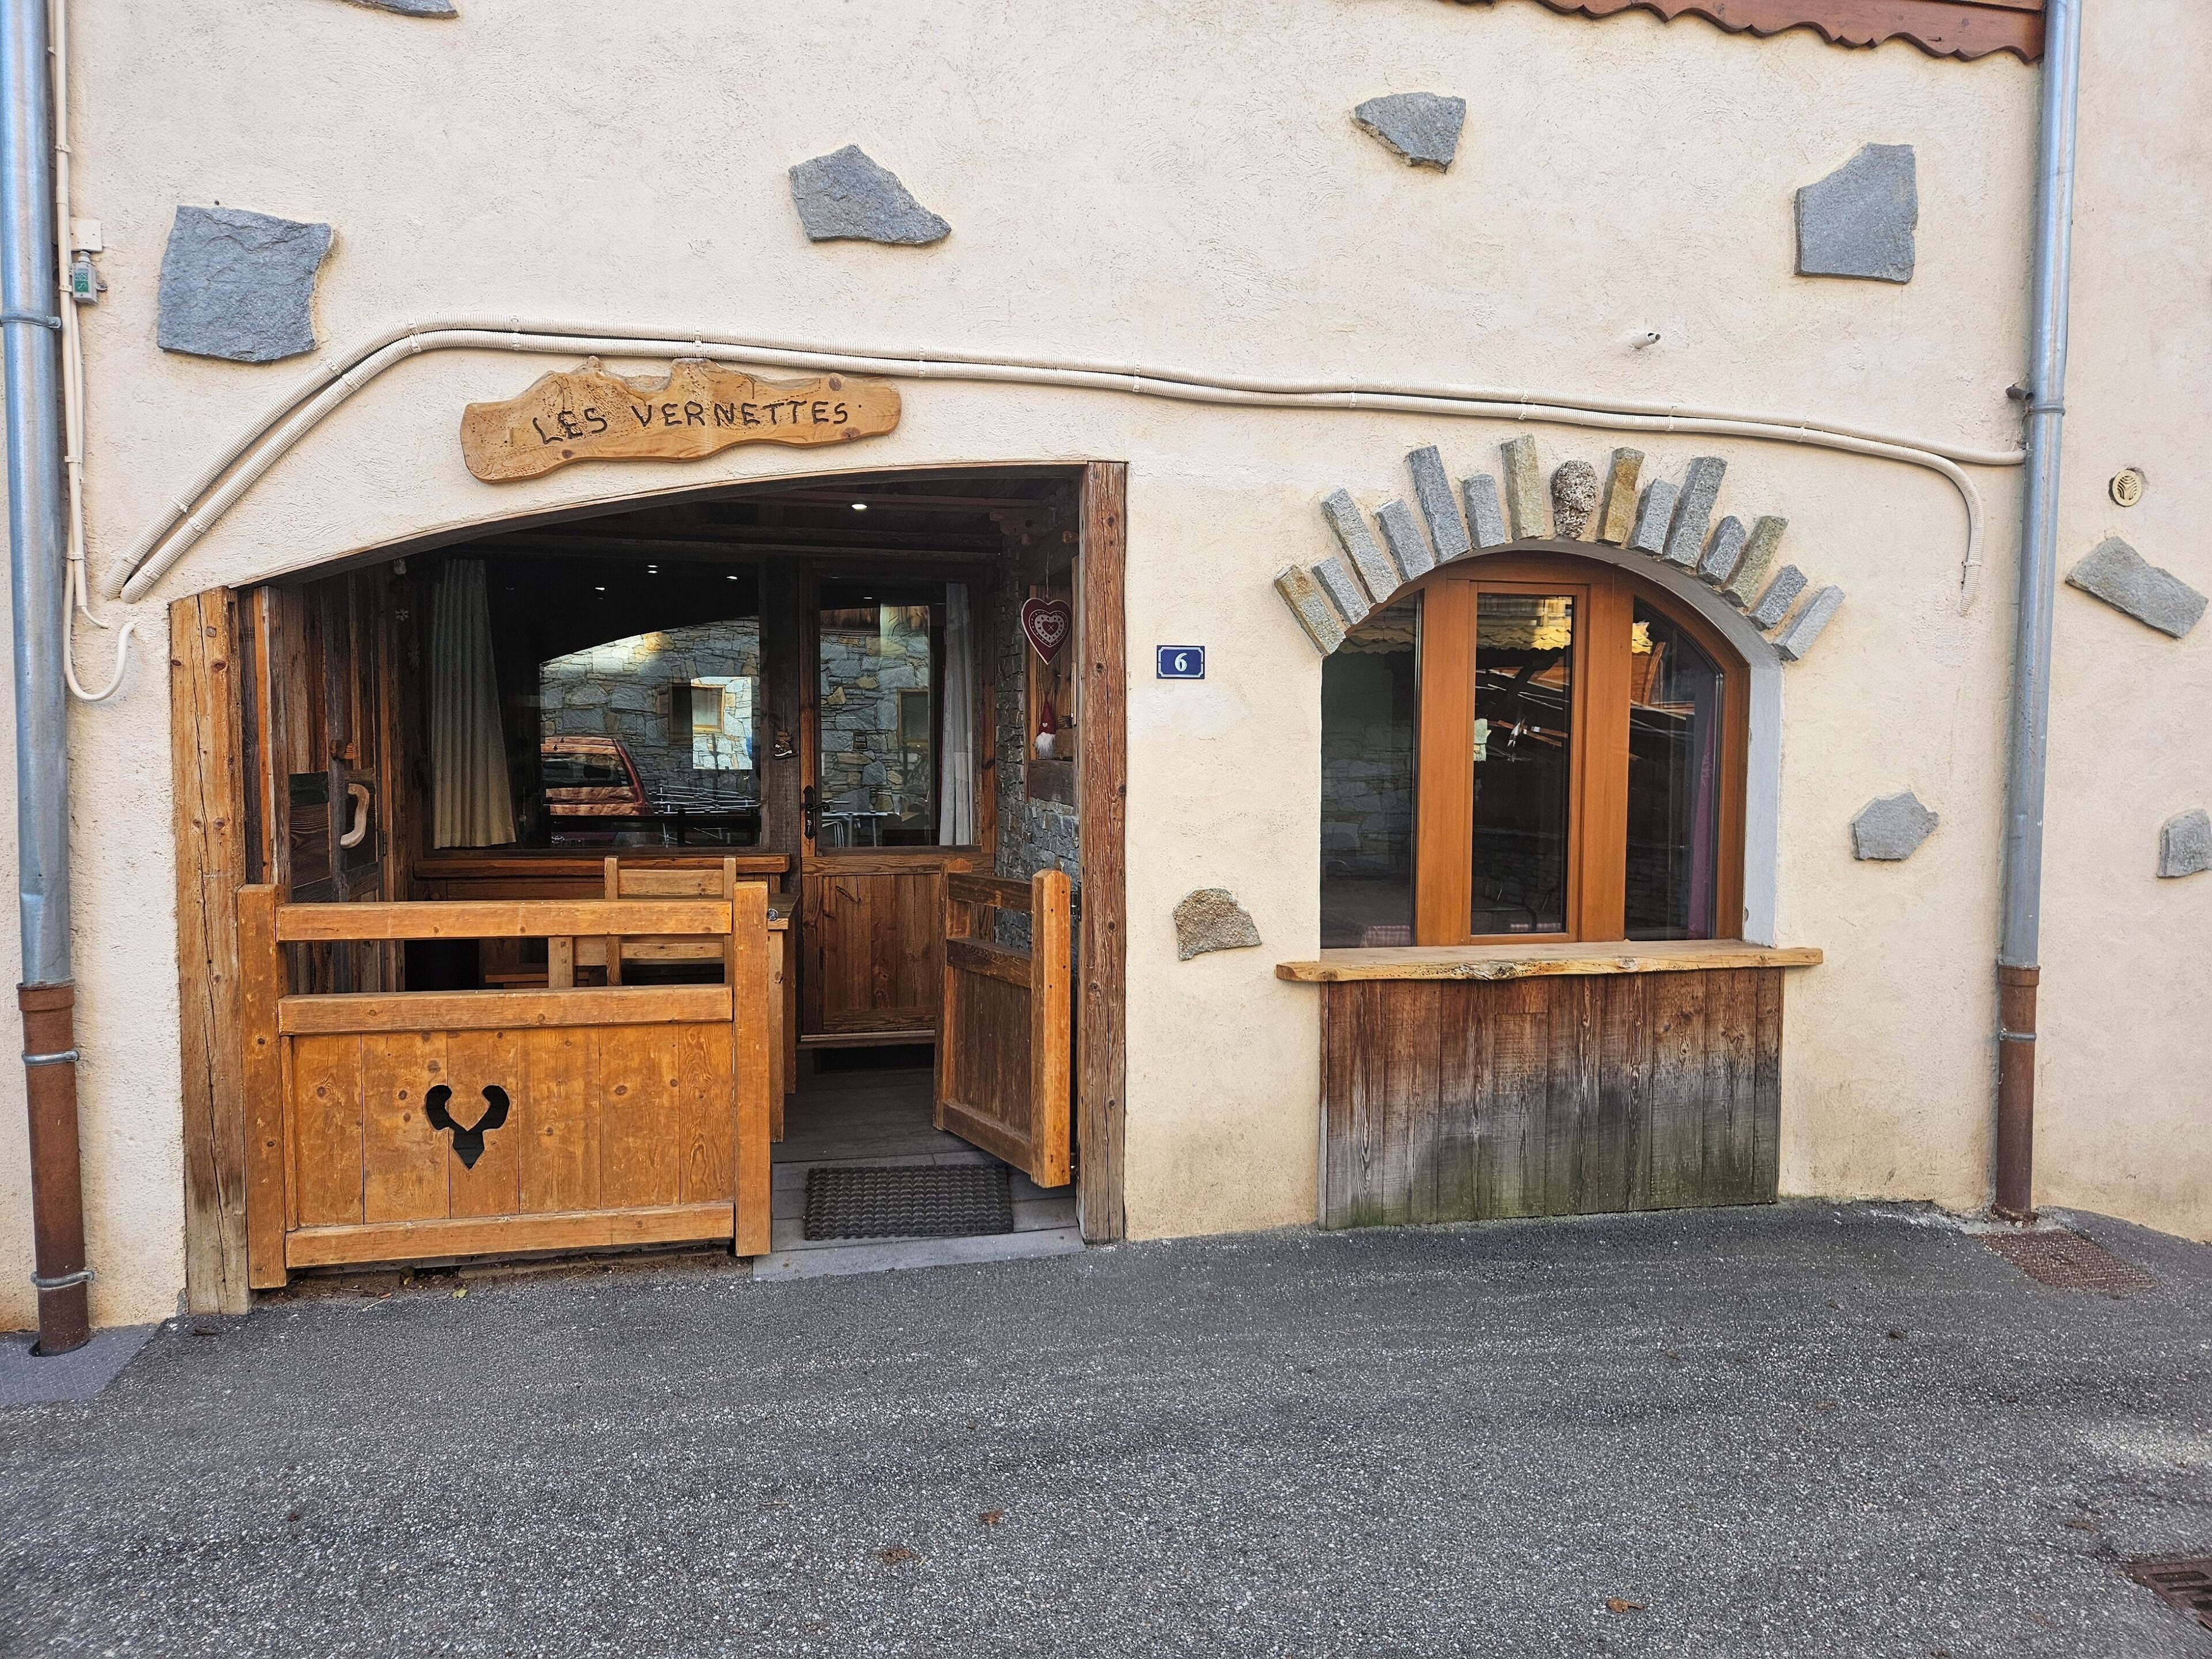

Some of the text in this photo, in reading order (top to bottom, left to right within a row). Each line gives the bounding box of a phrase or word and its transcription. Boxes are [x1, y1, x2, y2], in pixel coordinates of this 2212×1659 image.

[532, 400, 849, 445] LES VERNETTES
[1175, 652, 1187, 672] 6
